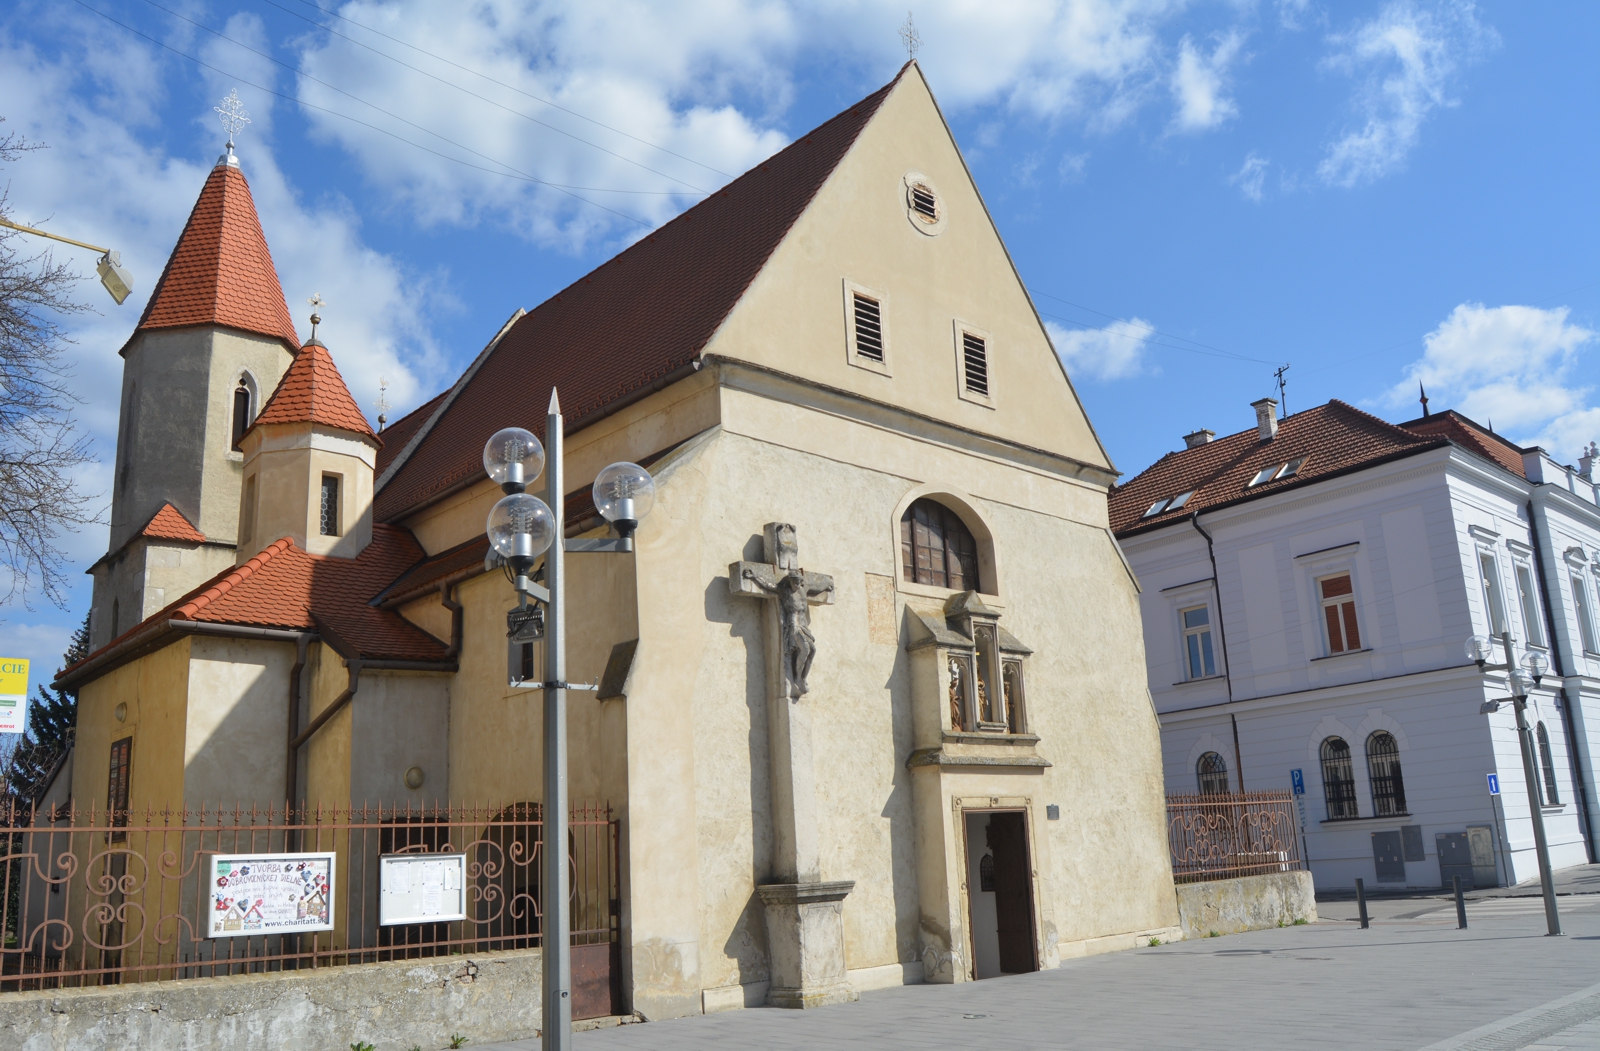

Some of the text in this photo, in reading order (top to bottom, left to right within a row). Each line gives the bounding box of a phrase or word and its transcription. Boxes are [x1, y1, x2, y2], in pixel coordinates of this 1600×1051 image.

[0, 663, 25, 674] CIE
[251, 864, 281, 873] TVORBA
[265, 918, 326, 927] www.charitatt.sk
